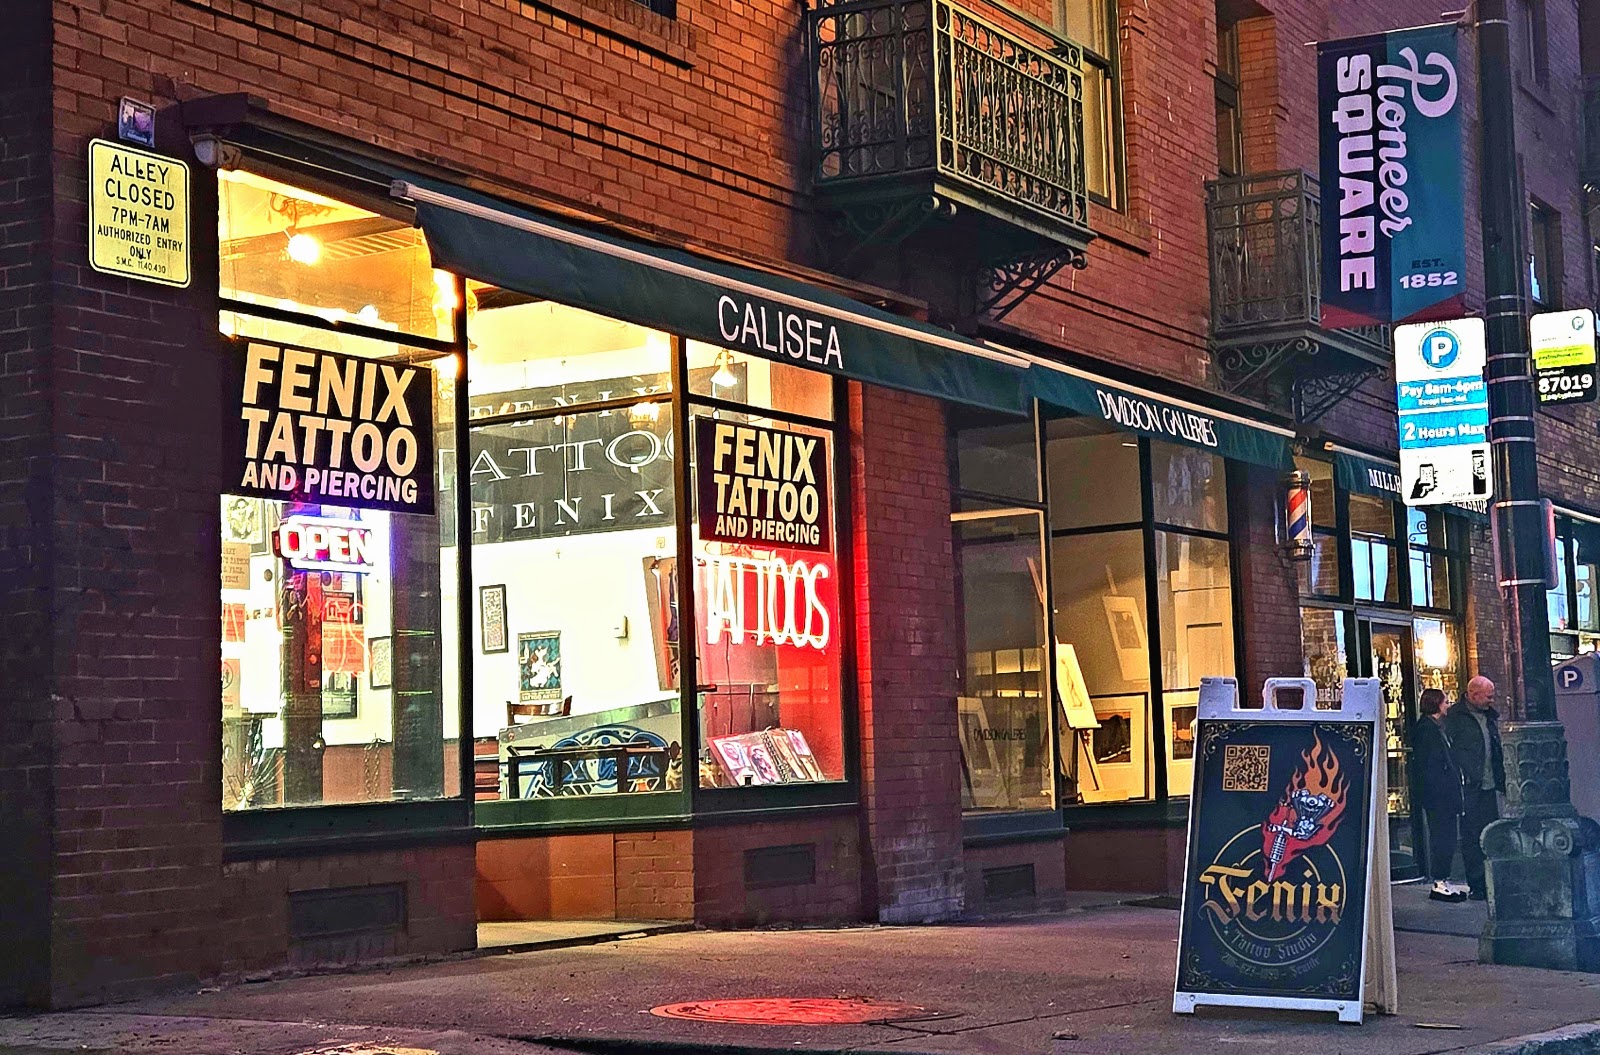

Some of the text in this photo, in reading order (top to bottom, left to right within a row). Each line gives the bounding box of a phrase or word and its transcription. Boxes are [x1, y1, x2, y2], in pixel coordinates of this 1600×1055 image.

[1377, 47, 1458, 238] Pioneer
[110, 154, 169, 184] ALLEY
[1332, 54, 1375, 292] SQUARE
[106, 178, 175, 211] CLOSED
[97, 224, 183, 252] AUTHORIZED ENTRY
[112, 206, 170, 233] 7PM-7AM
[129, 245, 152, 260] ONLY
[1411, 258, 1445, 269] EST.
[1399, 271, 1458, 289] 1852
[718, 295, 844, 369] CALISEA
[242, 342, 416, 426] FENIX
[1538, 374, 1593, 393] 87019
[1096, 389, 1218, 447] DAVIDSON GALLERIES
[1404, 422, 1416, 440] 2
[1418, 426, 1456, 439] Hours
[241, 407, 417, 477] TATTOO
[713, 423, 817, 484] FENIX
[241, 461, 417, 504] AND PIERCING
[713, 473, 819, 524] TATTOO
[471, 488, 664, 534] FENIX
[714, 514, 820, 545] AND PIERCING
[279, 524, 373, 566] OPEN
[700, 557, 830, 649] TATTOOS
[1198, 865, 1342, 926] Fenix
[1231, 928, 1317, 960] Tattoo Studio
